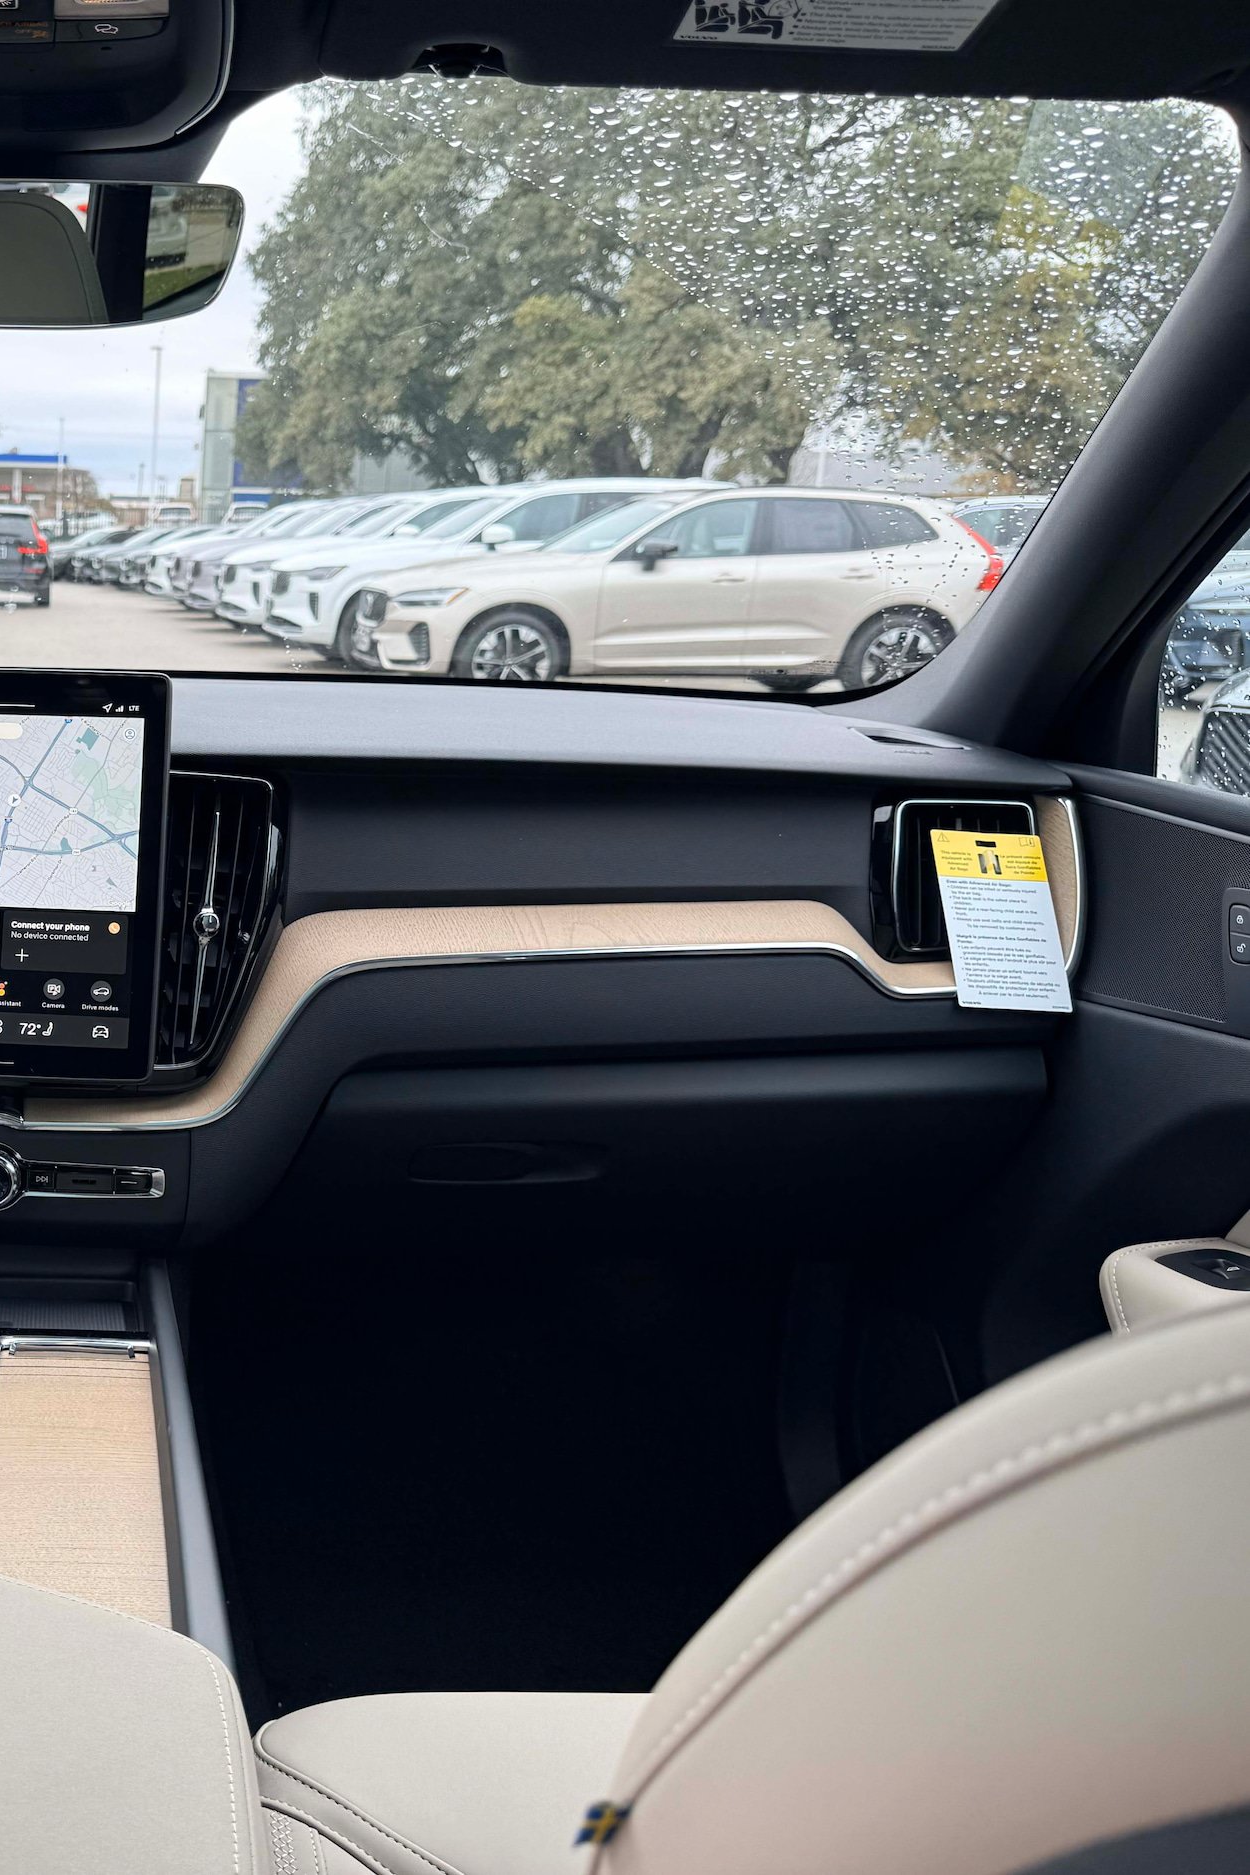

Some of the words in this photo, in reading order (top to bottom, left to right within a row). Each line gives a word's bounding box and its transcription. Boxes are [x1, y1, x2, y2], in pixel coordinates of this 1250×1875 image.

[11, 921, 44, 930] Connect
[45, 923, 63, 931] your
[64, 922, 90, 932] phone
[23, 931, 48, 940] device
[49, 933, 89, 942] connected
[81, 1003, 97, 1011] Drive
[98, 1004, 119, 1012] modes
[19, 1022, 42, 1036] 72°
